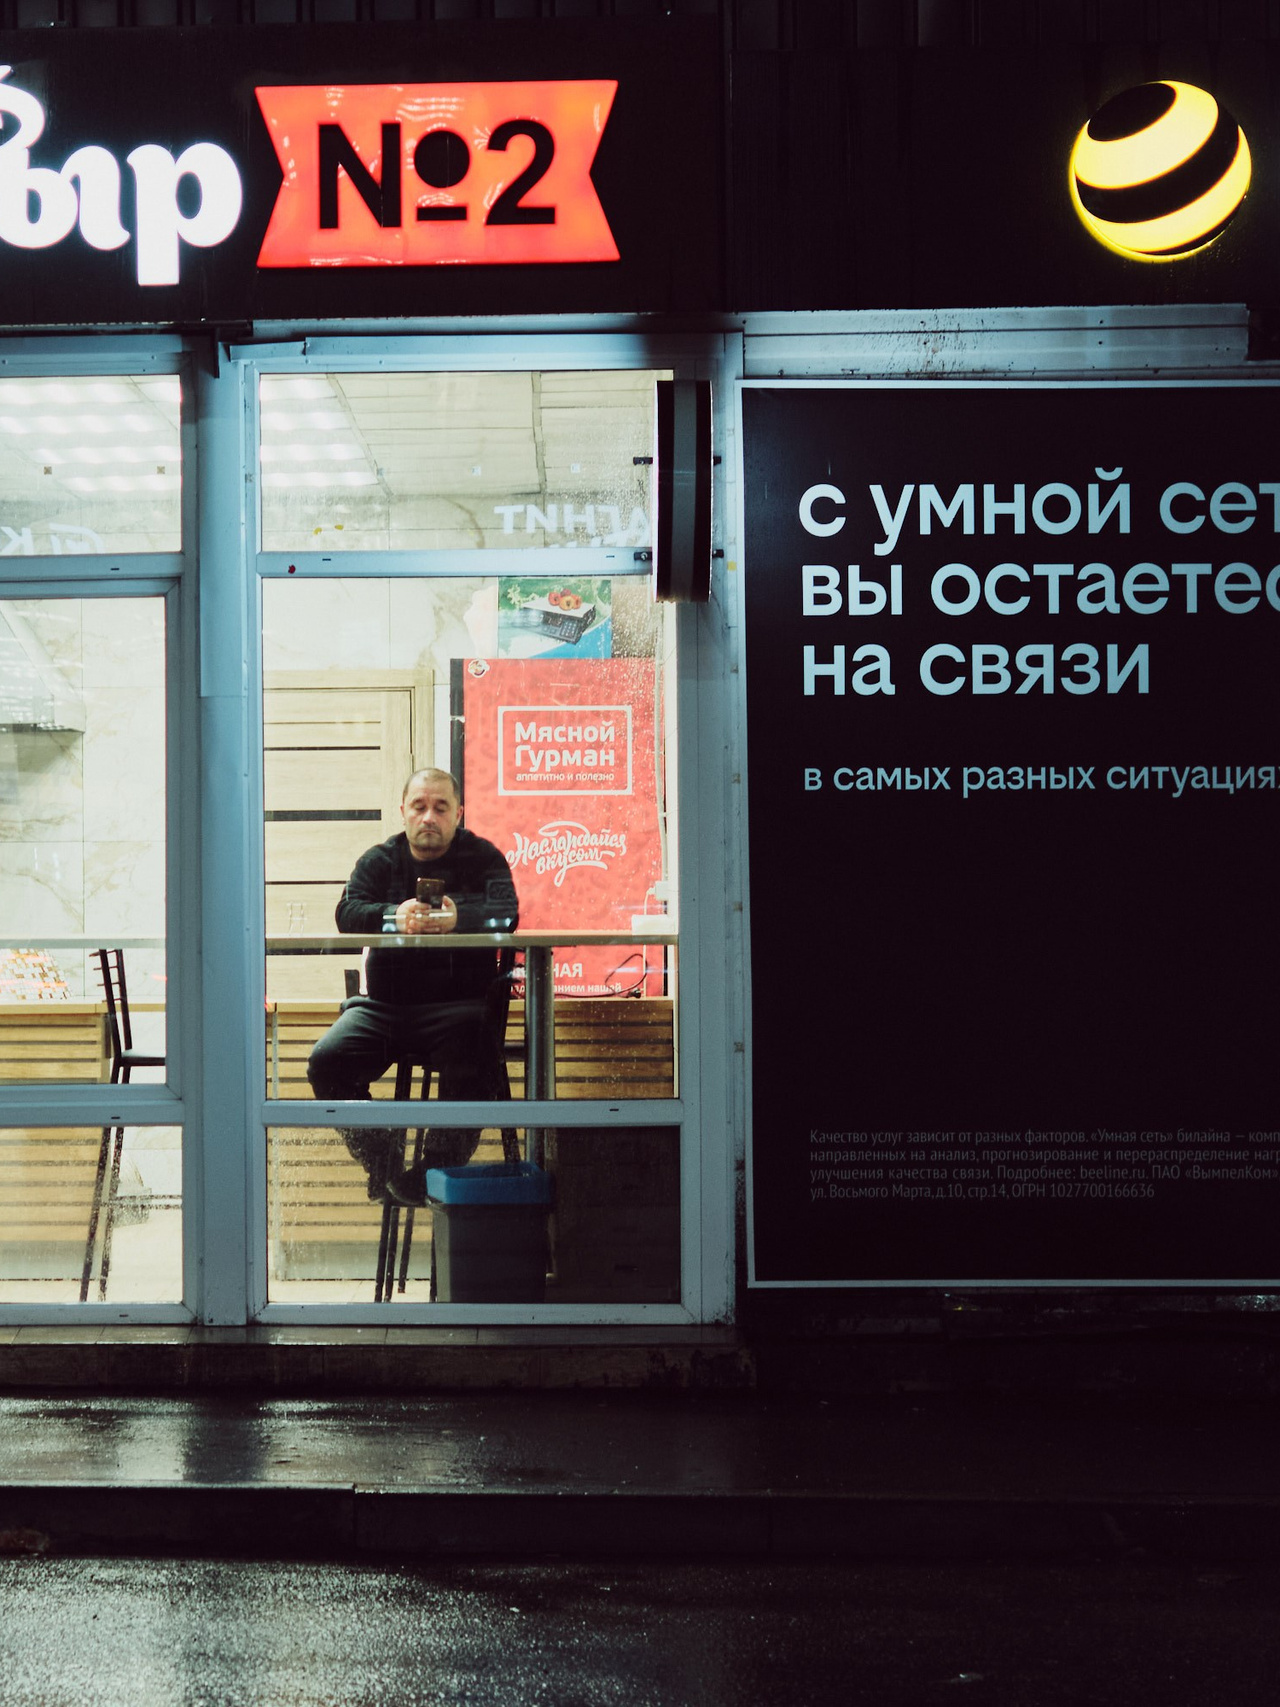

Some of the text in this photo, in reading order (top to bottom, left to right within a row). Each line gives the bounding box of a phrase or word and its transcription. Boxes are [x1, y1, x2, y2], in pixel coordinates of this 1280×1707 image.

[798, 483, 847, 538] с
[868, 466, 1131, 557] умной
[801, 563, 903, 617] вы
[803, 642, 1150, 696] на связи
[515, 720, 616, 743] Мясной
[515, 744, 615, 772] Гурман
[515, 772, 566, 782] аппетитно
[575, 772, 615, 782] полезно
[804, 766, 1280, 799] в самых разных ситуация
[505, 820, 627, 870] Наслаждайся
[535, 847, 617, 888] вкусом
[810, 1130, 868, 1143] Качество
[871, 1132, 903, 1147] услуг
[906, 1132, 956, 1143] зависит
[958, 1132, 972, 1143] от
[975, 1132, 1021, 1146] разных
[1024, 1129, 1089, 1146] факторов.
[1090, 1130, 1137, 1143] «Умная
[1140, 1131, 1173, 1143] сеть»
[1177, 1128, 1231, 1143] билайна
[810, 1150, 907, 1162] направленных
[910, 1150, 926, 1162] на
[930, 1150, 980, 1163] анализ,
[982, 1150, 1099, 1163] прогнозирование
[1103, 1150, 1111, 1161] и
[1115, 1149, 1250, 1163] перераспределение
[809, 1167, 884, 1183] улучшения
[888, 1167, 948, 1180] качества
[952, 1167, 994, 1180] связи.
[997, 1164, 1077, 1182] Подробнее:
[1080, 1164, 1150, 1180] beeline.ru.
[1152, 1164, 1181, 1180] ПАО
[810, 1187, 827, 1202] ул.
[829, 1184, 889, 1199] Восьмого
[1011, 1183, 1046, 1198] ОГРН
[1050, 1182, 1155, 1198] 1027700166636
